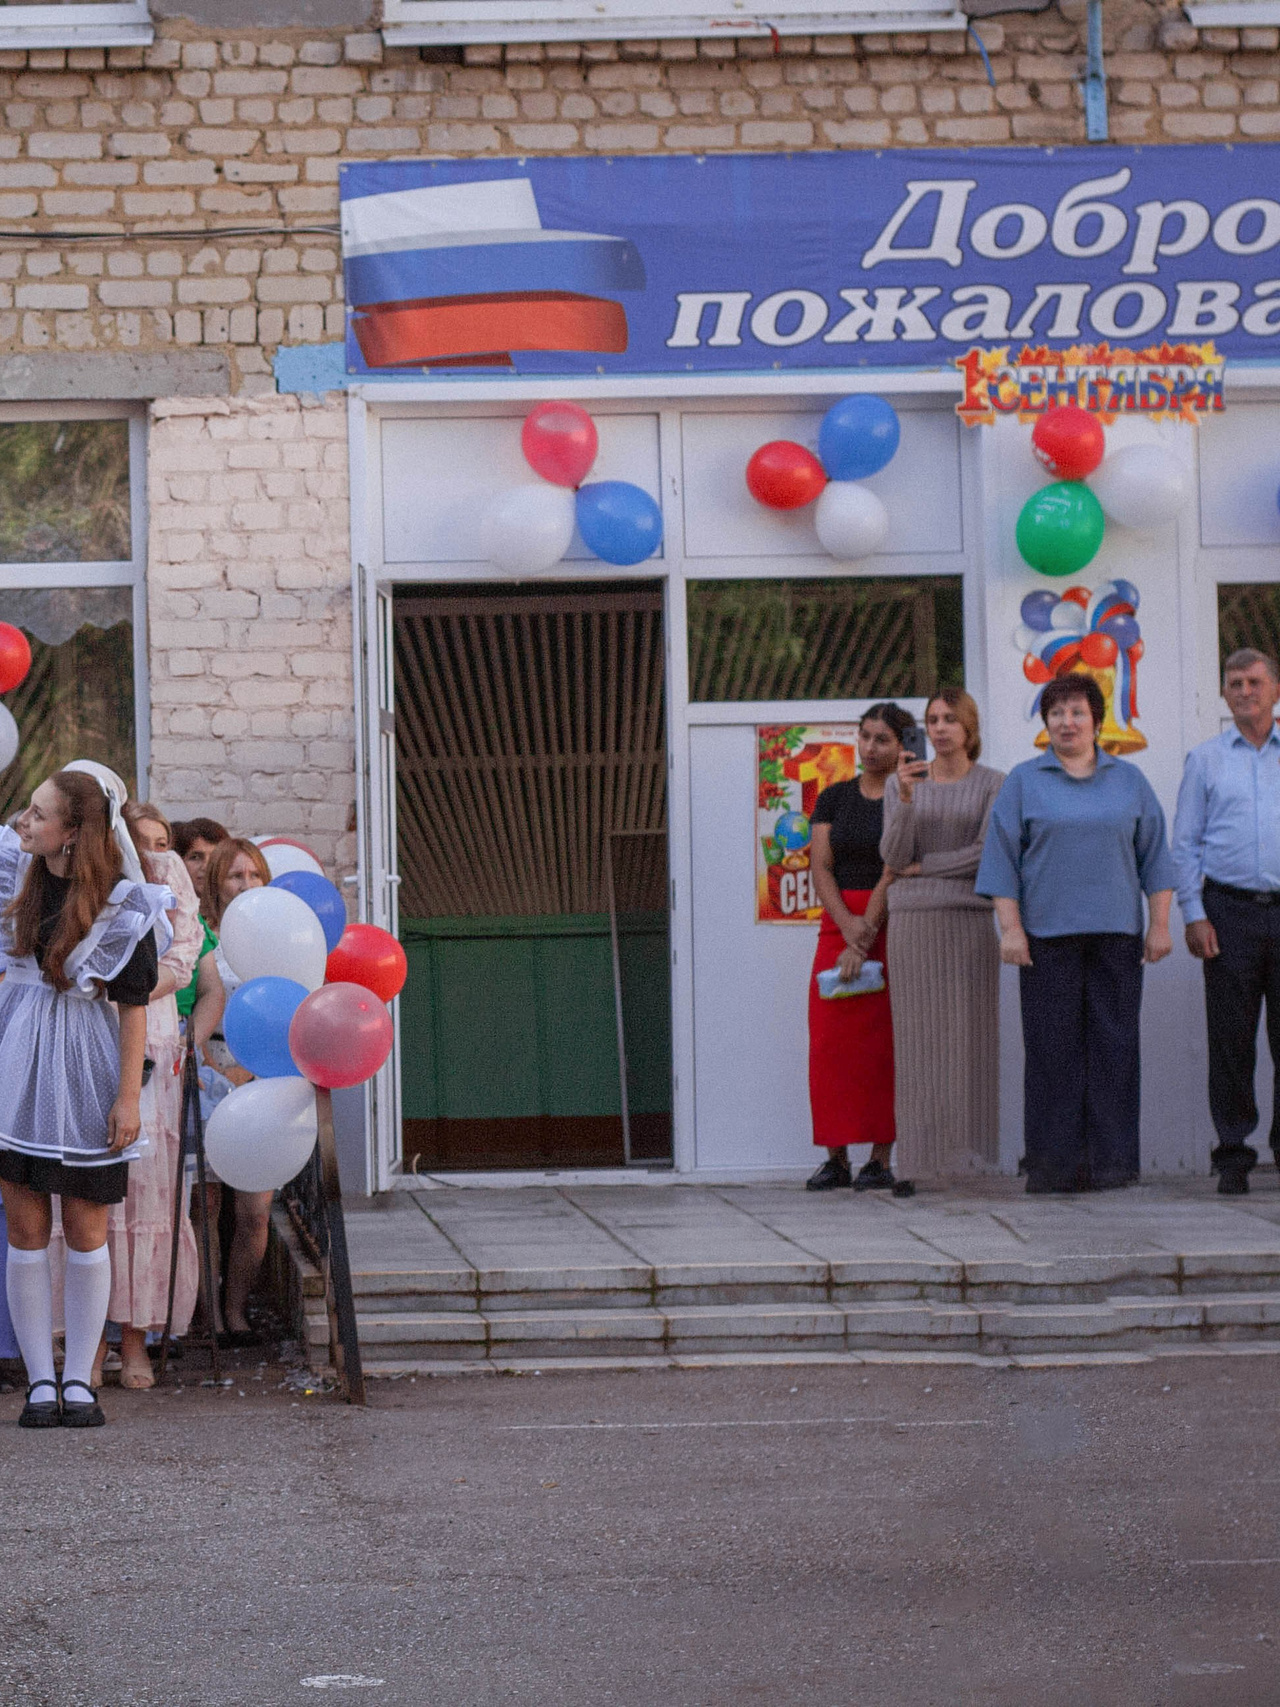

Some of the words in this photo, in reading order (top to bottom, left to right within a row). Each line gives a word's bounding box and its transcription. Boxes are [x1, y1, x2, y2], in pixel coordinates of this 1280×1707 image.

[860, 166, 1280, 275] Добро
[956, 349, 991, 412] 1
[988, 364, 1226, 413] СЕНТЯБРЯ
